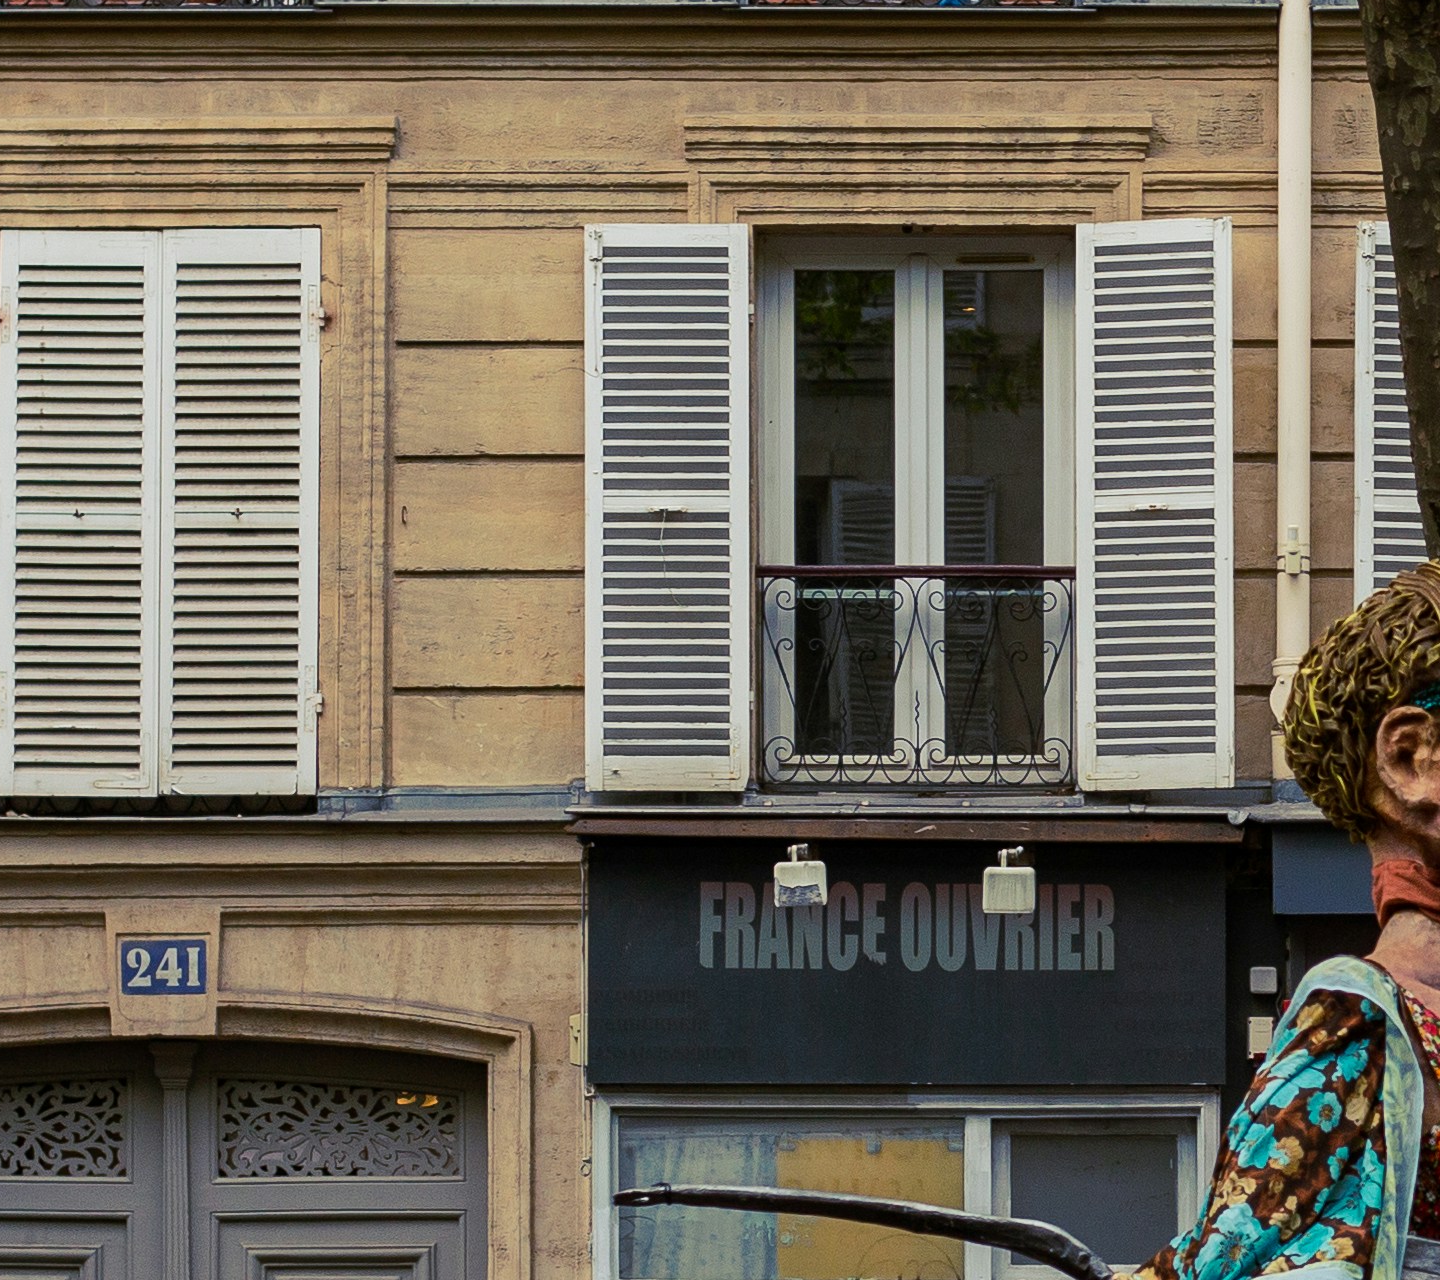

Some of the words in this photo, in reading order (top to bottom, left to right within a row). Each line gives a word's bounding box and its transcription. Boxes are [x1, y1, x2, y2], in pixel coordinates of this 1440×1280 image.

[699, 880, 887, 973] FRANCE
[899, 881, 1116, 973] OUVRIER
[126, 947, 201, 988] 241
